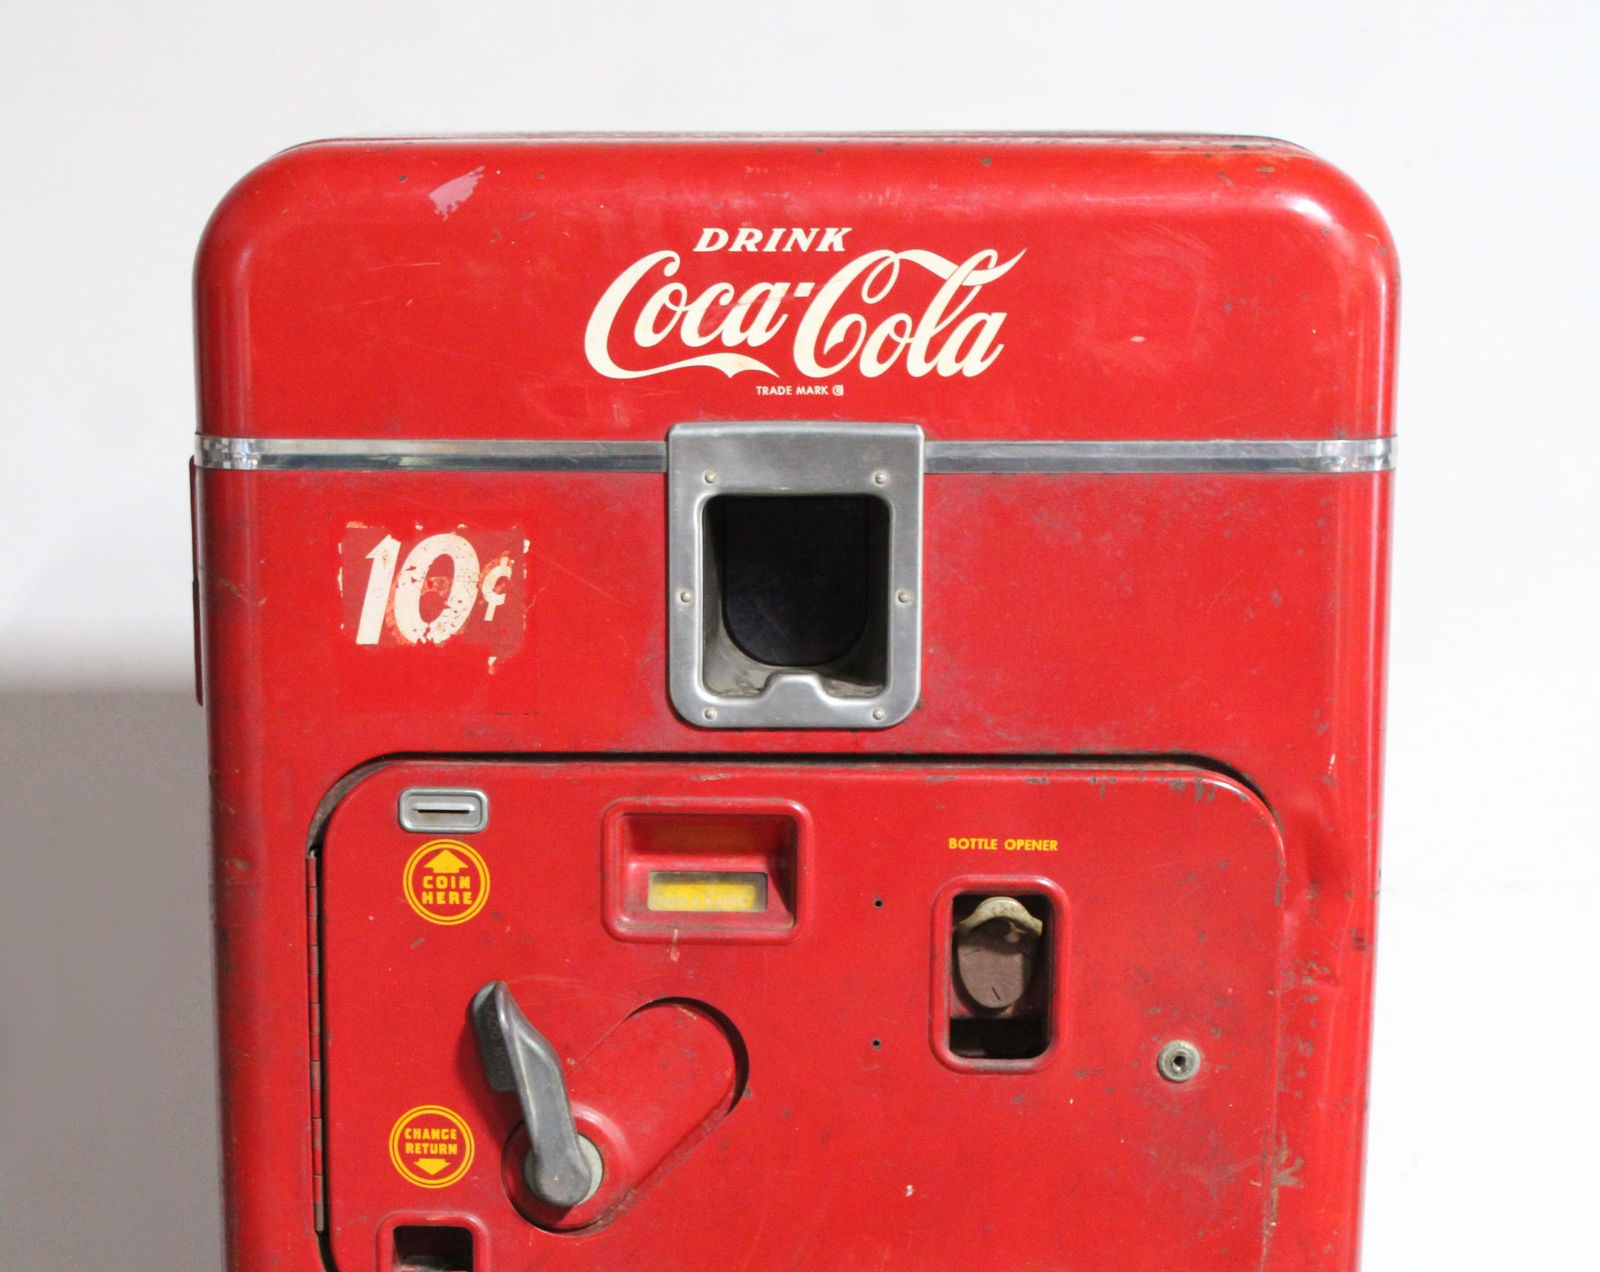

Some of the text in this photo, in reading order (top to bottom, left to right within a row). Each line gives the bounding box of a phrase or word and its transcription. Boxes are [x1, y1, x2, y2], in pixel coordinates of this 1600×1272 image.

[692, 226, 853, 253] DRINK
[583, 247, 1028, 380] Coca-Cola
[755, 385, 793, 396] TRADE
[796, 385, 829, 396] MARK
[948, 837, 1059, 852] BOTTLE OPENER
[422, 875, 471, 889] COIN
[421, 891, 473, 905] HERE
[404, 1127, 458, 1140] CHANGE
[405, 1142, 458, 1155] RETURN
